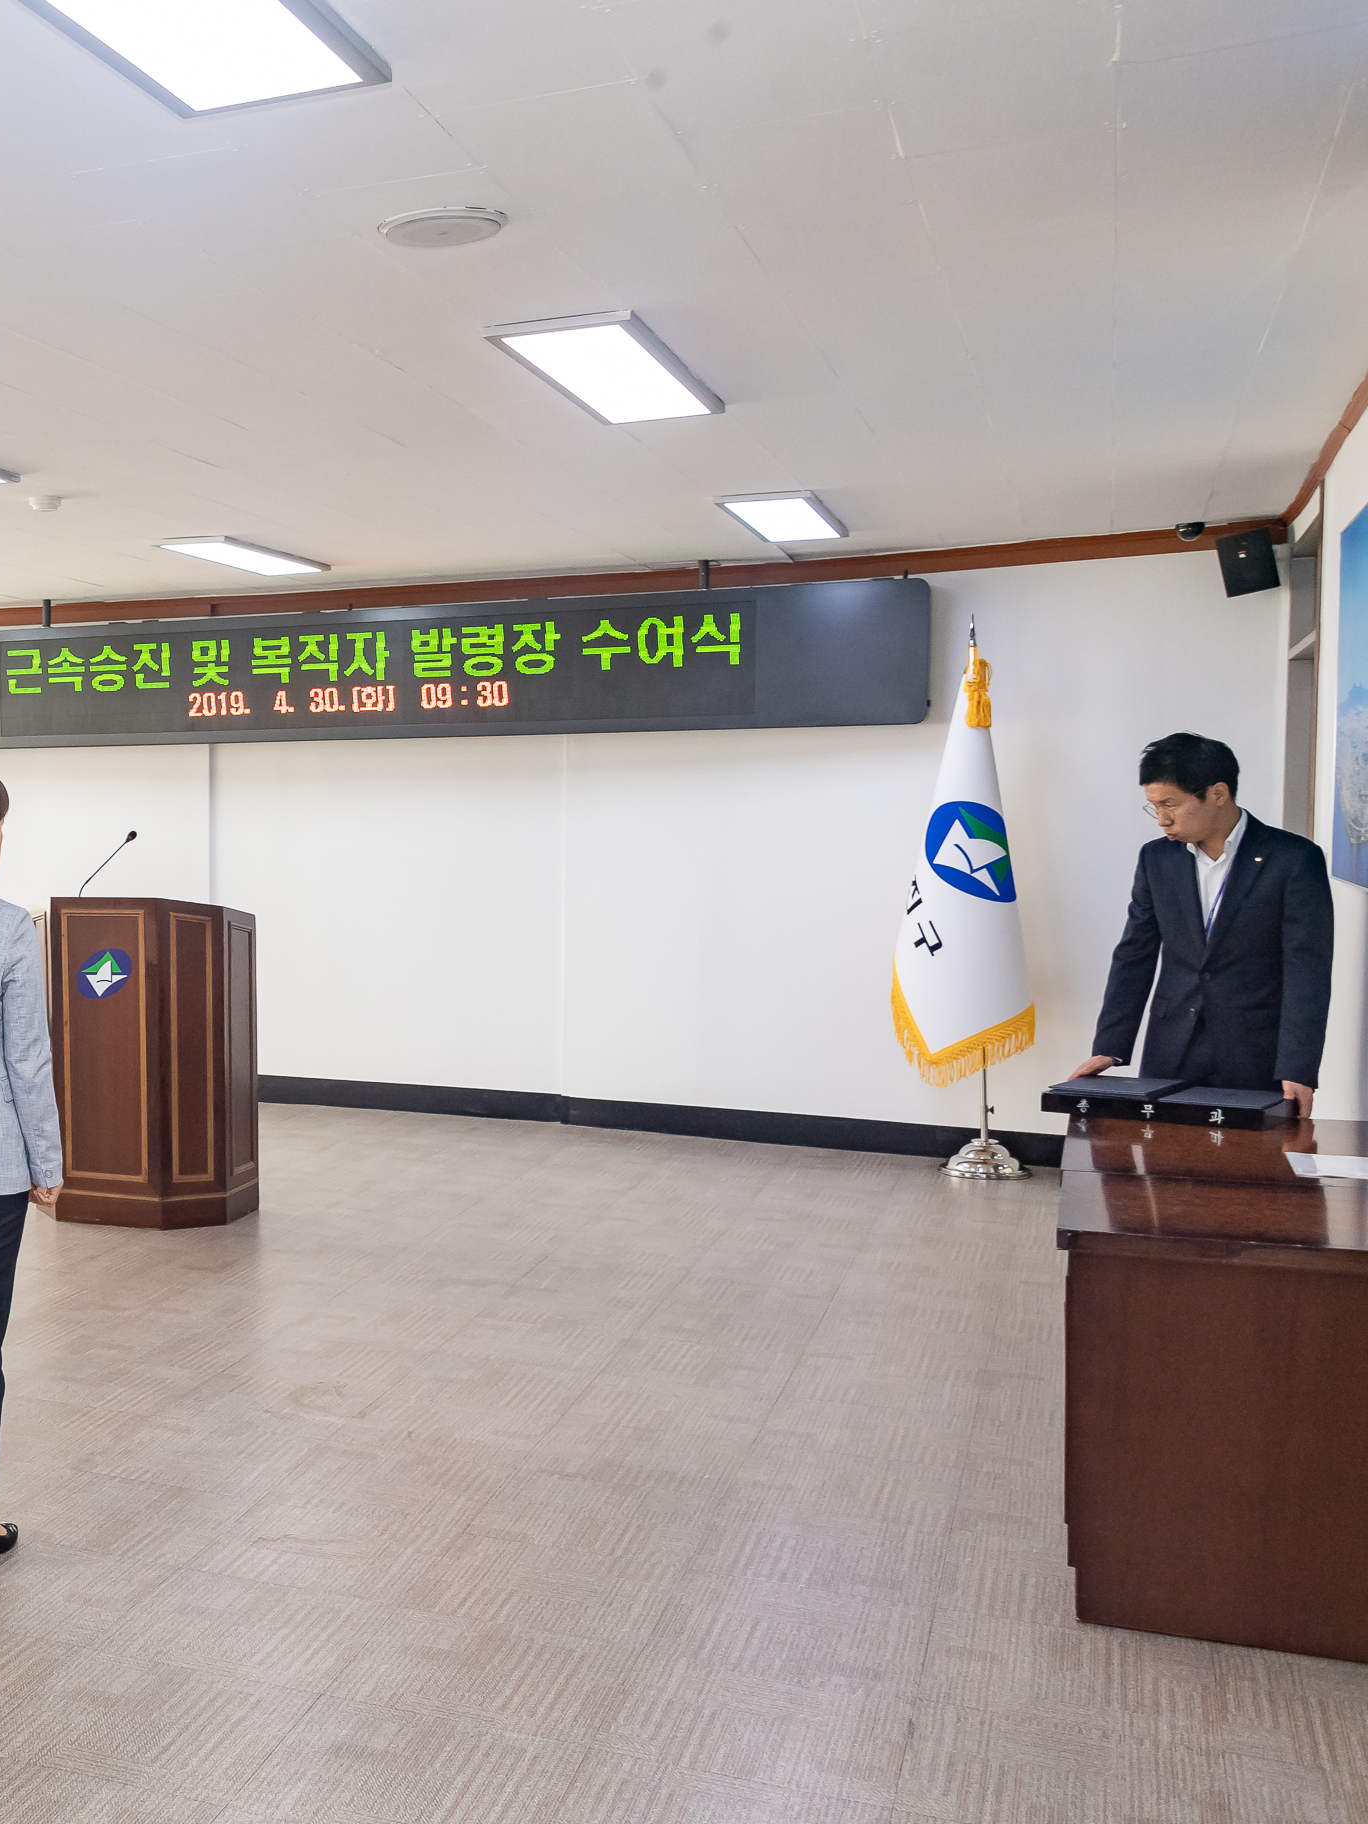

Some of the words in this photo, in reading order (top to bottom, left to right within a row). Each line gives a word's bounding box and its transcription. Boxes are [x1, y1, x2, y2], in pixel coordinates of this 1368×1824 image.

[6, 642, 171, 694] 근속승진
[191, 639, 230, 687] 및
[251, 631, 390, 683] 복직자
[411, 621, 562, 678] 발령장
[582, 613, 741, 671] 수여식
[188, 690, 251, 717] 2019.
[273, 690, 295, 714] 4.
